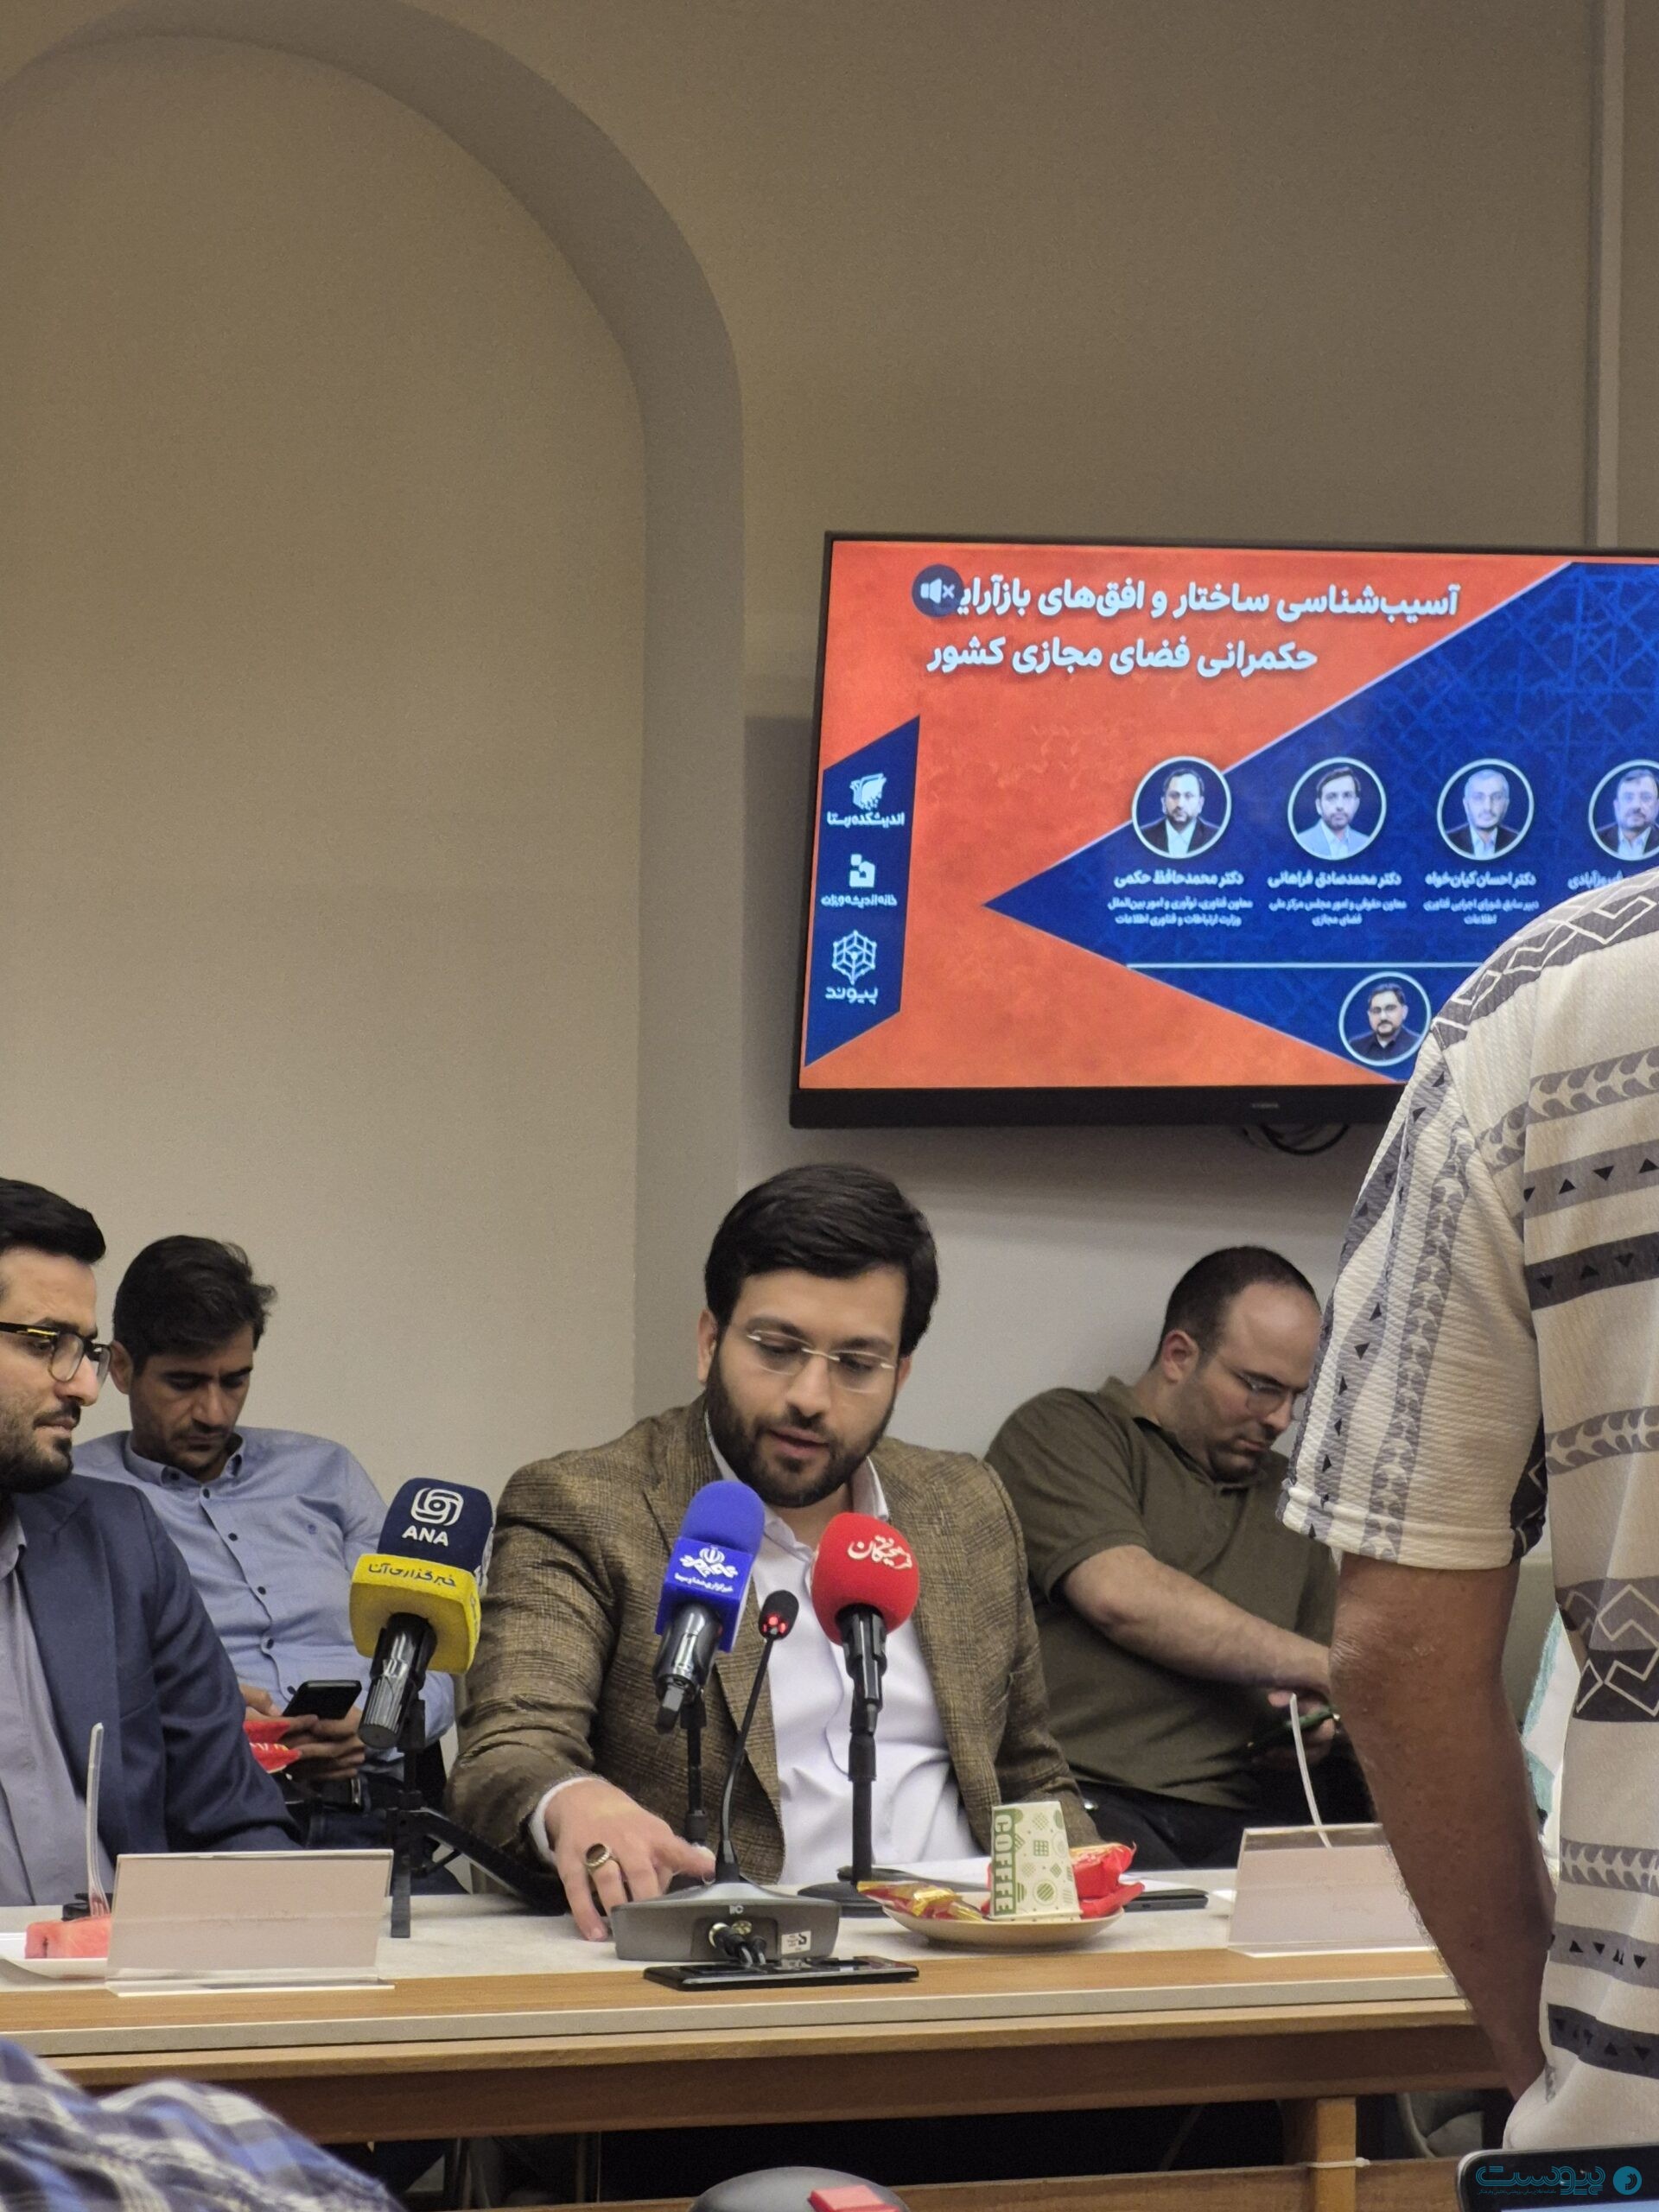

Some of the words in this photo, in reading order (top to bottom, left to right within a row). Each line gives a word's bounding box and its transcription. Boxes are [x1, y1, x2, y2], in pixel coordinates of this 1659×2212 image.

[956, 574, 1031, 616] بازآرای
[1038, 576, 1145, 618] افق‌های
[1150, 589, 1167, 619] و
[1173, 581, 1269, 620] ساختار
[1276, 583, 1460, 623] آسیب‌شناسی
[925, 635, 1007, 674] کشور
[1012, 636, 1103, 674] مجازی
[1109, 635, 1190, 675] فضای
[1197, 639, 1318, 678] حکمرانی
[852, 810, 906, 829] اندیشکده
[1113, 869, 1152, 888] حکمی
[1153, 868, 1218, 885] محمدحافظ
[1217, 869, 1244, 888] دکتر
[1267, 868, 1314, 888] فراهانی
[1314, 870, 1377, 889] محمدصادق
[1377, 870, 1402, 889] دکتر
[1477, 871, 1512, 888] احسان
[1512, 871, 1536, 889] دکتر
[878, 893, 898, 906] خانه
[1227, 897, 1253, 911] معاون
[824, 986, 879, 1005] پیوند
[402, 1524, 449, 1547] ANA
[368, 1562, 391, 1574] آنا
[390, 1567, 456, 1586] خبرگزاری
[995, 1815, 1014, 1912] COFFEE
